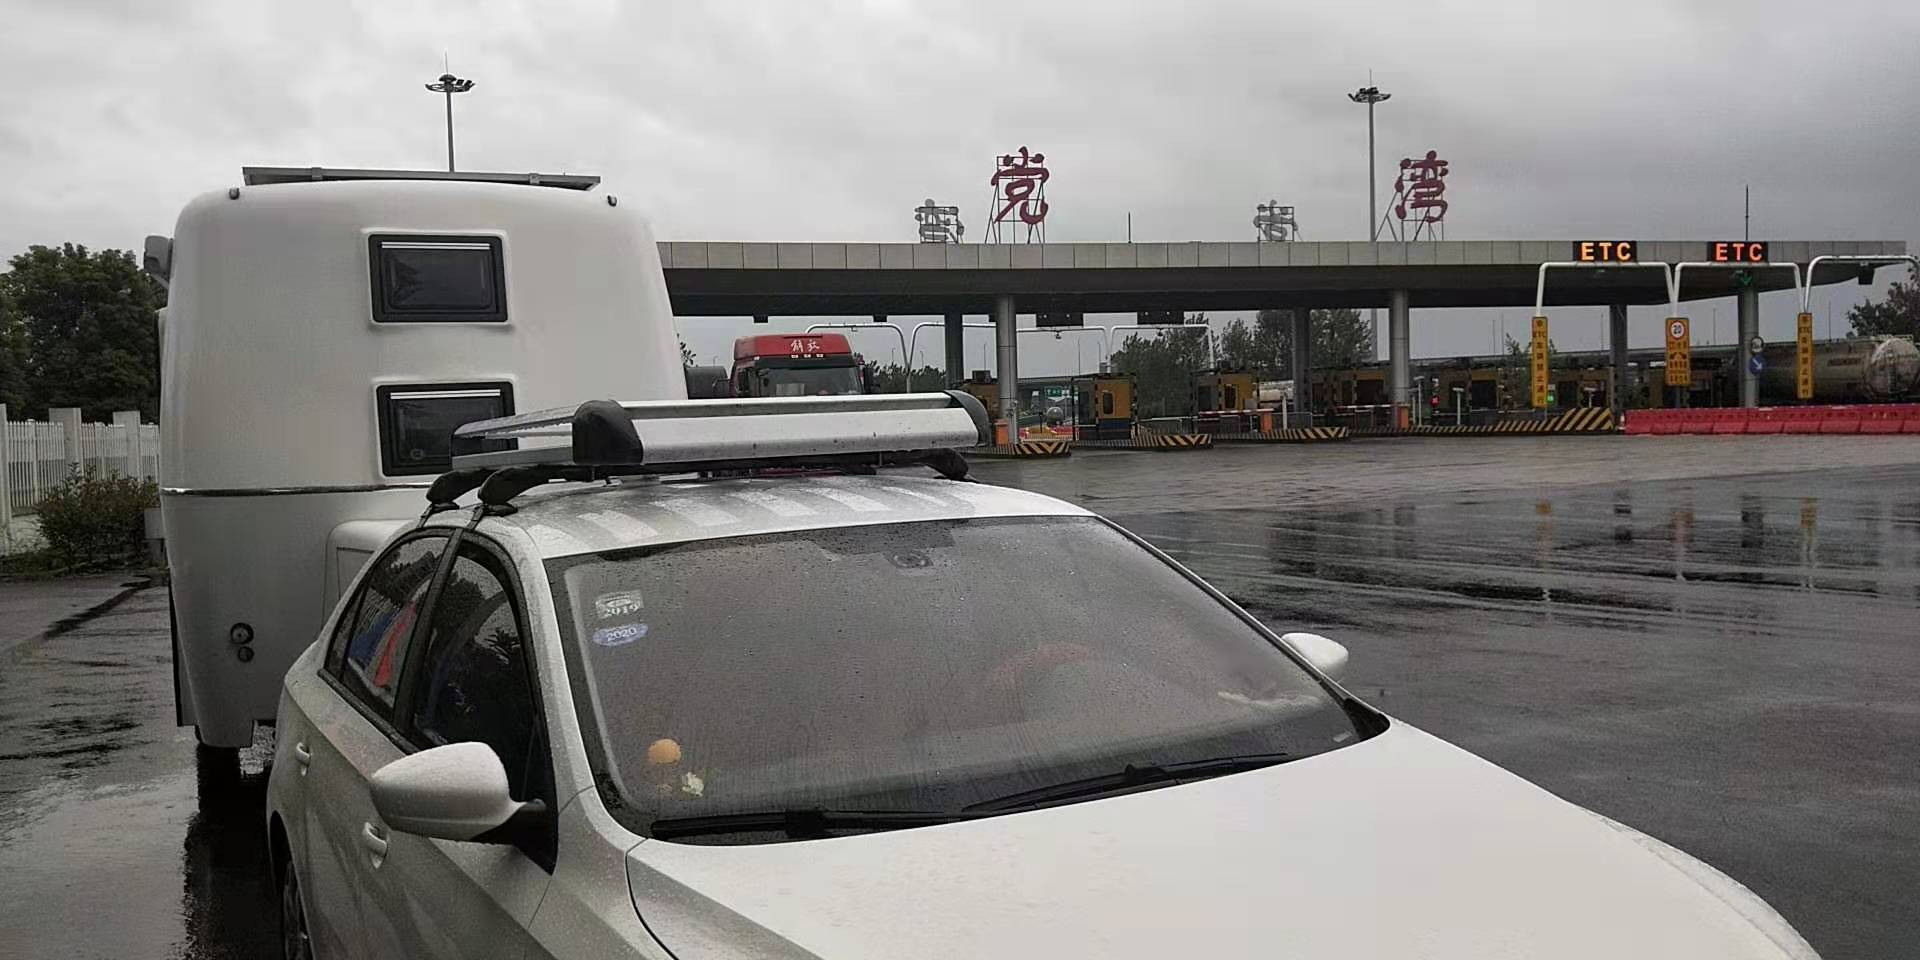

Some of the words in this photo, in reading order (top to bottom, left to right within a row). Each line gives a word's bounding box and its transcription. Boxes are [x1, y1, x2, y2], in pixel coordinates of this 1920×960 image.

[991, 146, 1049, 224] 党
[1395, 150, 1449, 223] 湾
[1581, 242, 1631, 261] ETC
[1716, 243, 1762, 261] ETC
[790, 339, 821, 353] 解放
[604, 602, 640, 618] 2019
[607, 627, 637, 641] 2020
